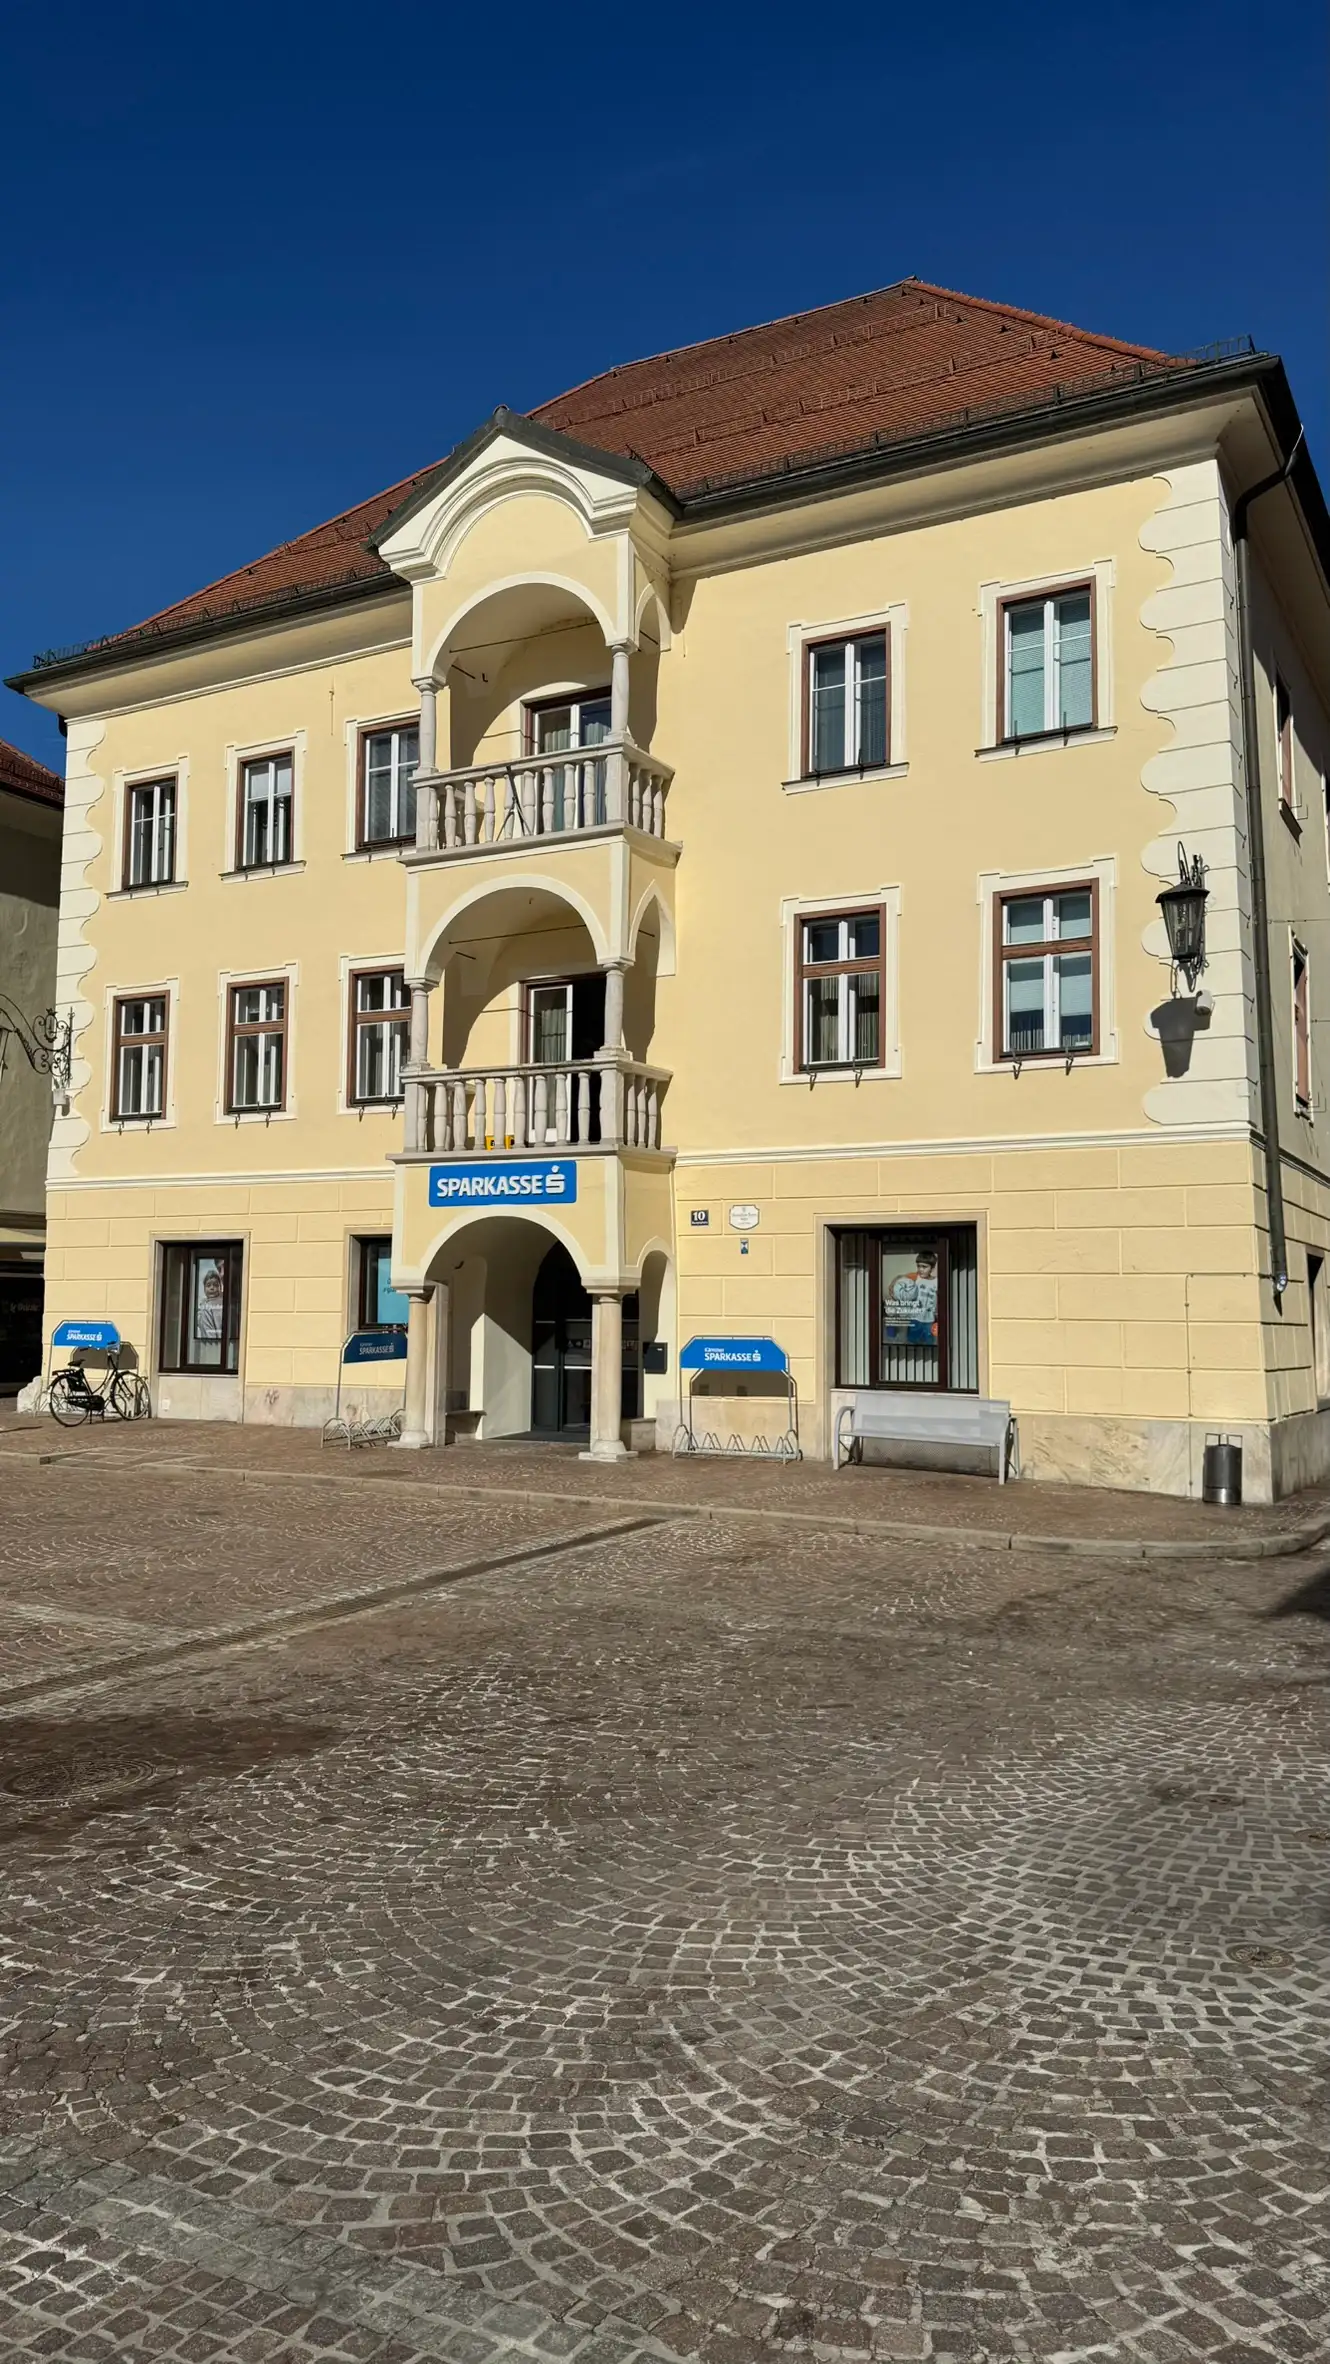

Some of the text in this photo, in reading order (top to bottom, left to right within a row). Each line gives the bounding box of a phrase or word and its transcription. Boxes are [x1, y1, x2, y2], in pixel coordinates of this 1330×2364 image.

[437, 1174, 543, 1197] SPARKASSE
[692, 1211, 706, 1221] 10
[900, 1299, 920, 1308] bringt
[66, 1333, 97, 1341] SPARKASSE
[359, 1345, 389, 1356] SPARKASSE
[704, 1352, 752, 1362] SPARKASSE
